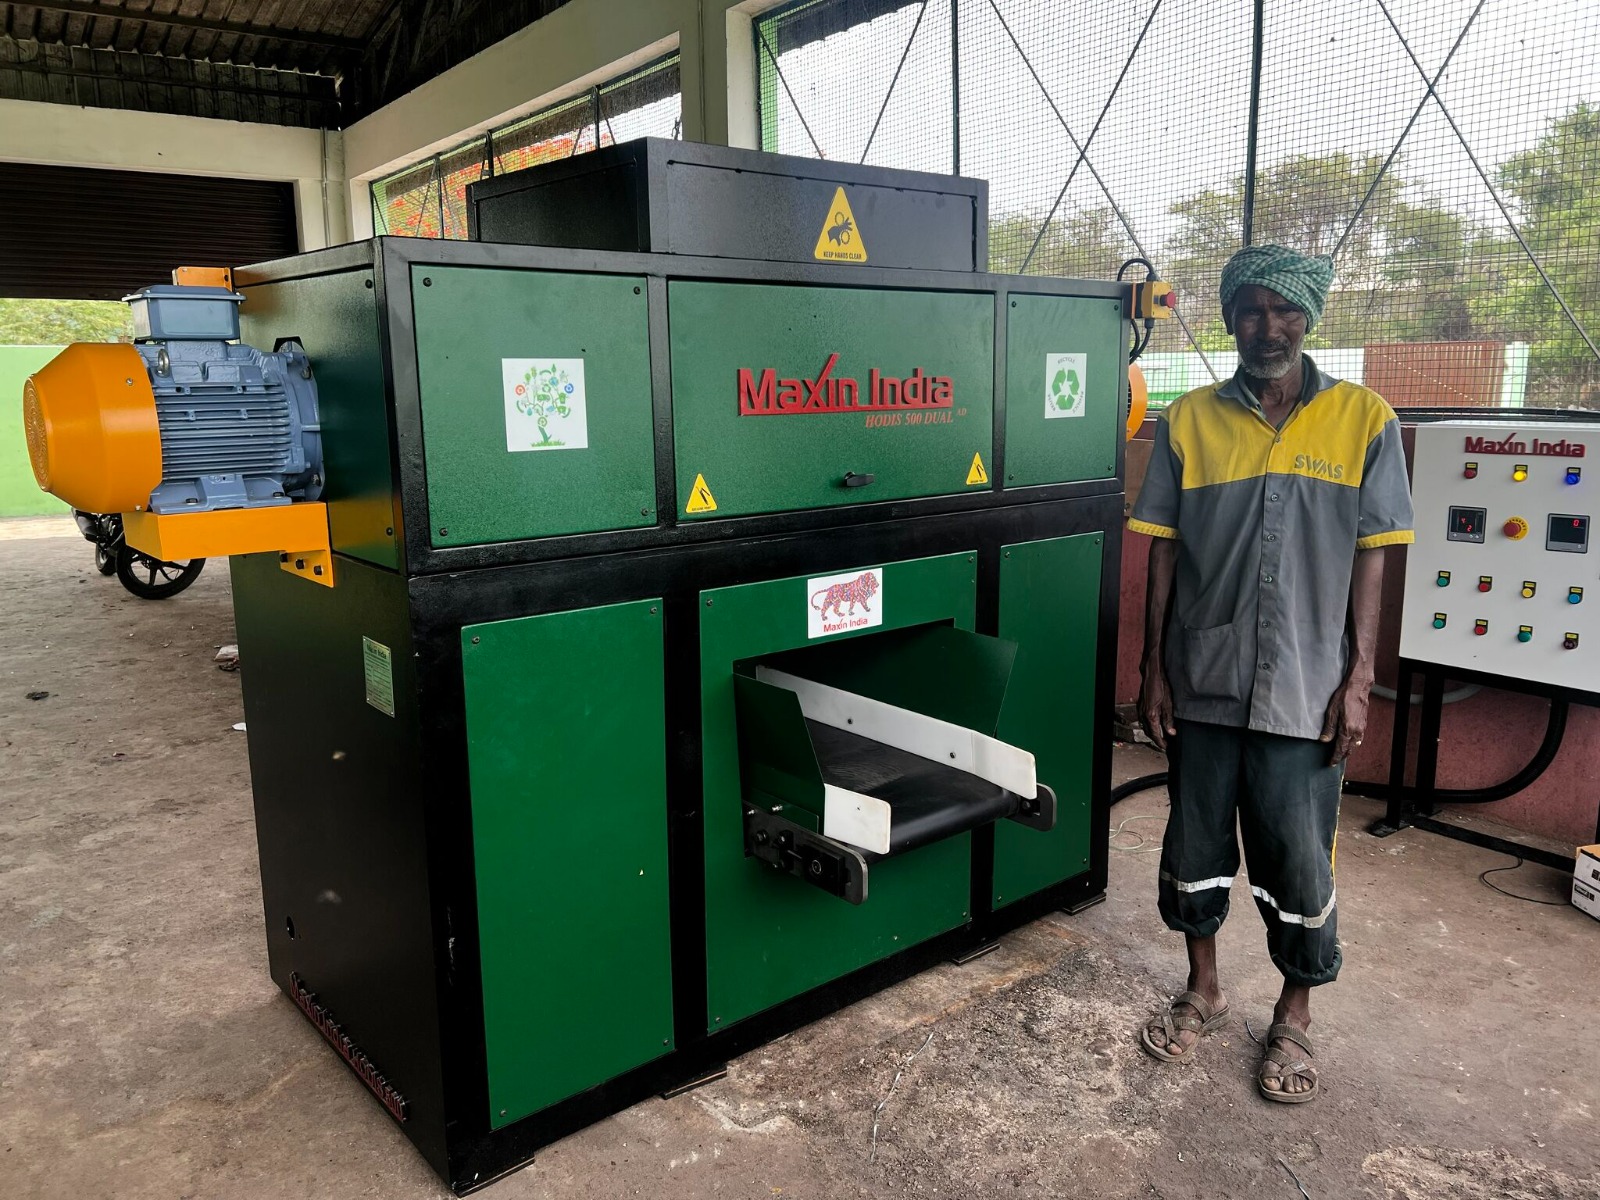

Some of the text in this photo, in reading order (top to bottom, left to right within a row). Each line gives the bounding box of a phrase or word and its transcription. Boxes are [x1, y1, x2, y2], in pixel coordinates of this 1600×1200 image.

[737, 352, 953, 416] Maxin India
[865, 414, 902, 428] HODIS
[904, 412, 923, 426] 500
[924, 411, 954, 425] DUAL
[1464, 432, 1585, 457] Maxin India
[823, 617, 868, 632] Maxin India
